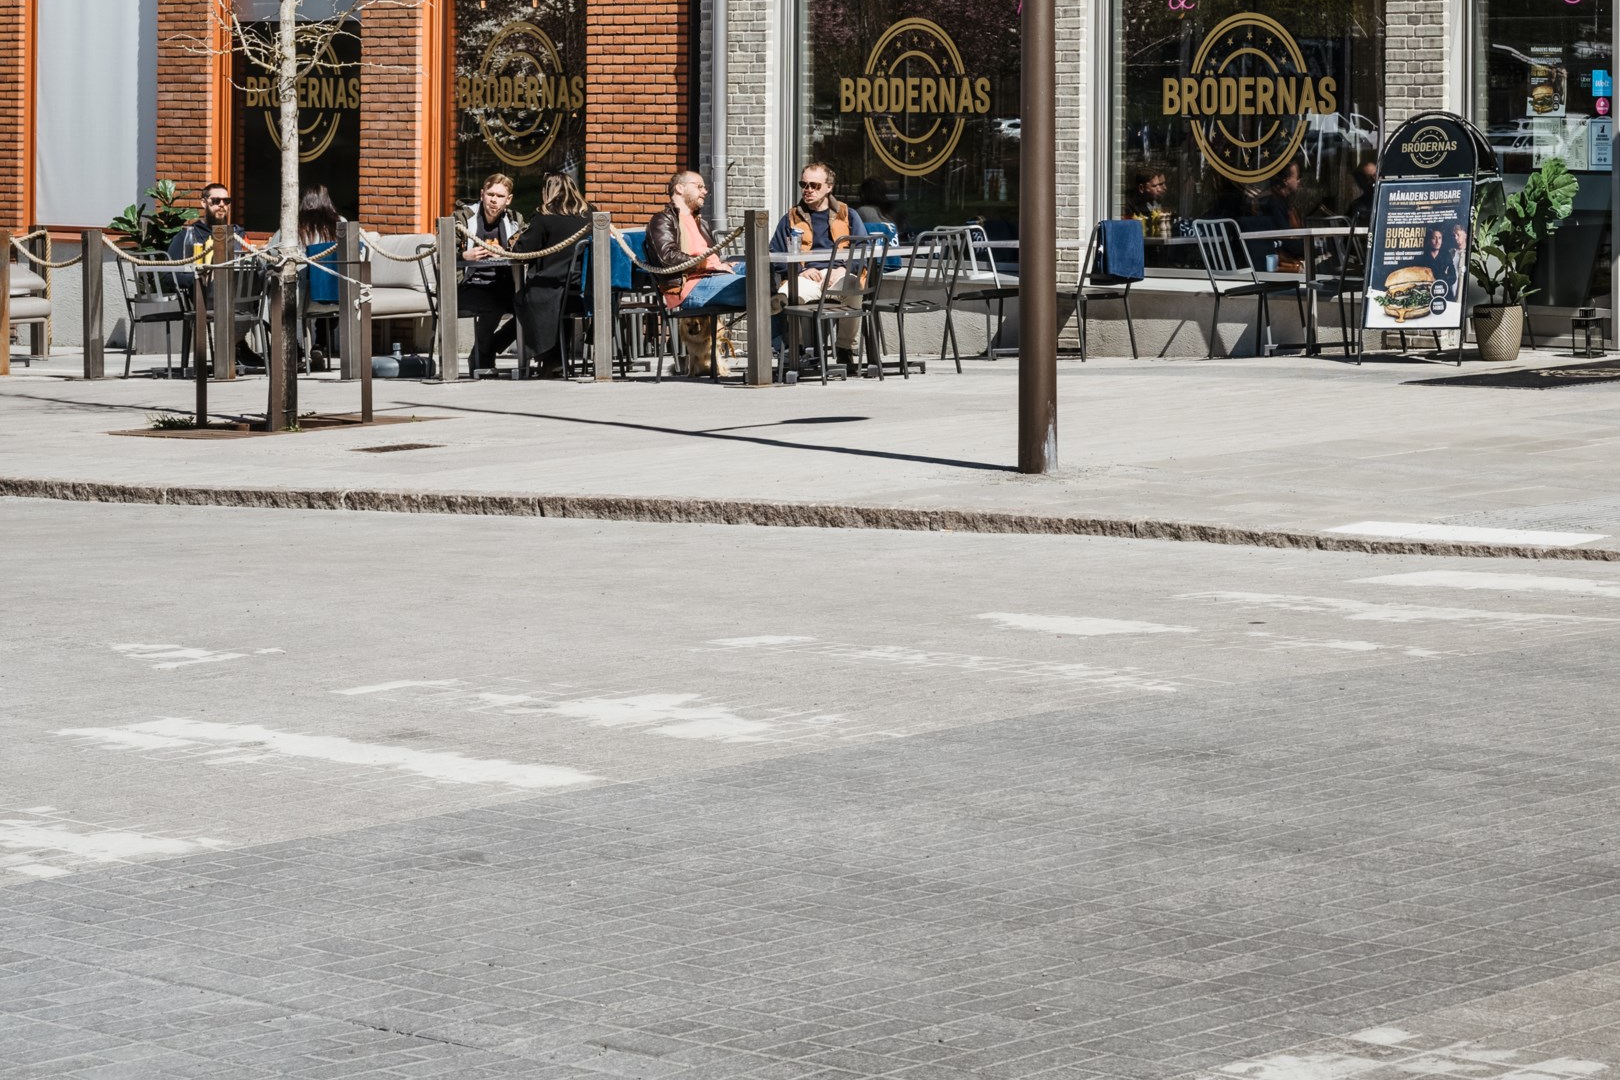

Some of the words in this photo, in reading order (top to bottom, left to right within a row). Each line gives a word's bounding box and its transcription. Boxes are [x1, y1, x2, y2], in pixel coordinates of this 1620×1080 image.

[840, 71, 991, 114] BRÖDERNAS
[1162, 70, 1337, 116] BRÖDERNAS
[1401, 140, 1458, 153] BRÖDERNAS
[1388, 190, 1429, 202] MÅNADENS
[1429, 189, 1462, 200] BURGARE
[1385, 226, 1427, 238] BURGARN
[1384, 238, 1397, 249] DU
